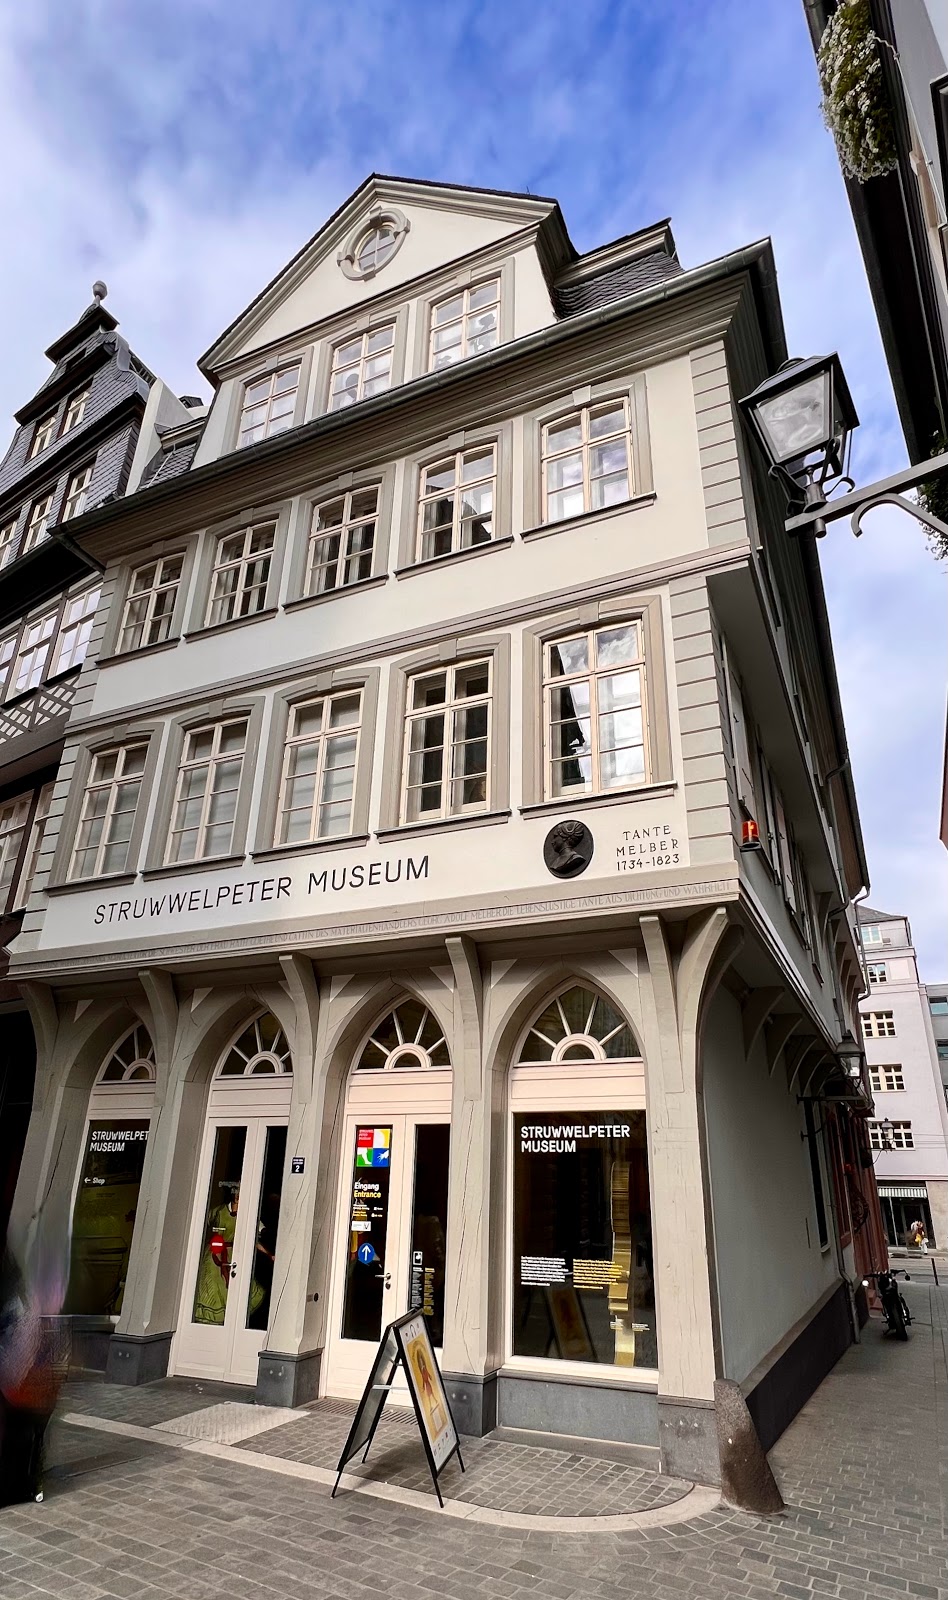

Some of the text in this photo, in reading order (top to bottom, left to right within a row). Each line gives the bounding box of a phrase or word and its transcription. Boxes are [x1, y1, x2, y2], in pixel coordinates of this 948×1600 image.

[623, 825, 671, 841] TANTE
[616, 838, 679, 857] MELBER
[616, 853, 680, 871] 1734-1823
[94, 855, 429, 925] STRUWWELPETER MUSEUM
[515, 900, 576, 915] LEBENSLUSTIGE
[577, 896, 603, 908] TANTE
[603, 894, 622, 905] AUS
[624, 889, 661, 902] DICHTUNG
[662, 887, 679, 898] UND
[521, 1125, 630, 1138] STRUWWELPETER
[90, 1142, 125, 1152] MUSEUM
[521, 1140, 576, 1152] MUSEUM
[354, 1182, 379, 1191] Eingang
[354, 1190, 381, 1198] Entrance
